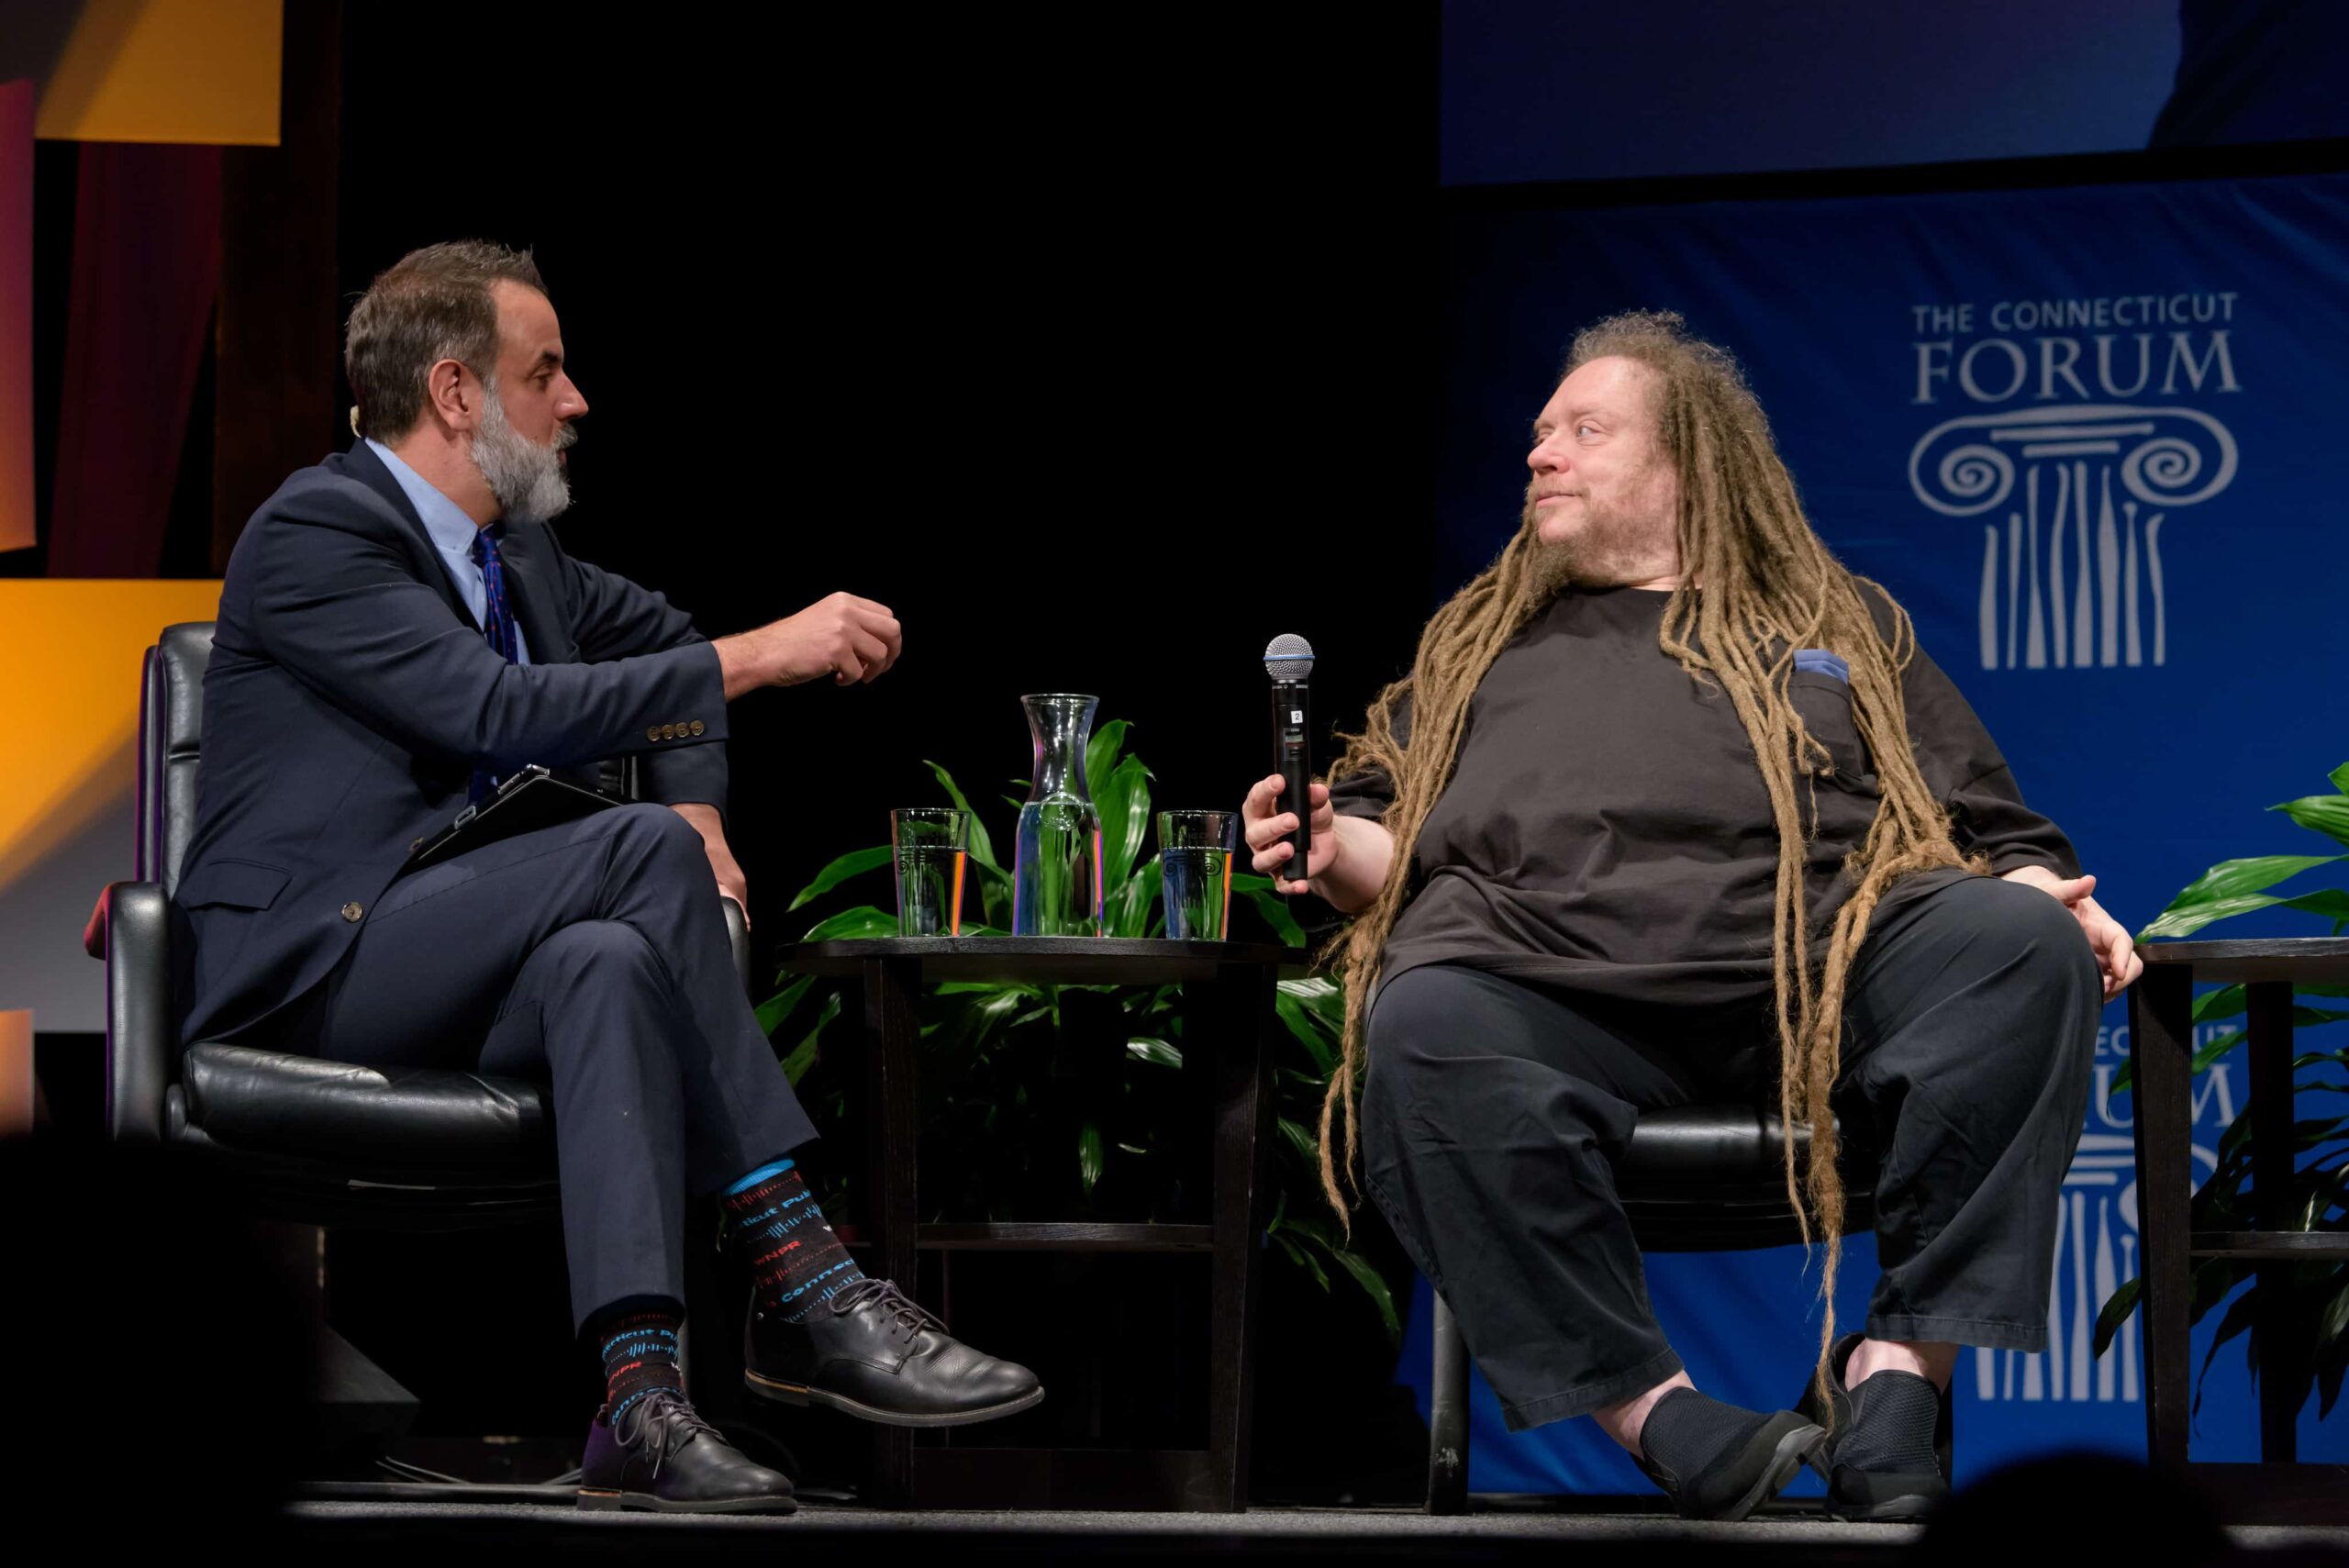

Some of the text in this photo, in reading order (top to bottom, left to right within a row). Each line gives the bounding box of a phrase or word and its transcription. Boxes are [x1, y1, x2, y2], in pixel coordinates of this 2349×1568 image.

[1911, 292, 2239, 334] THE CONNECTICUT
[1910, 329, 2243, 404] FORUM
